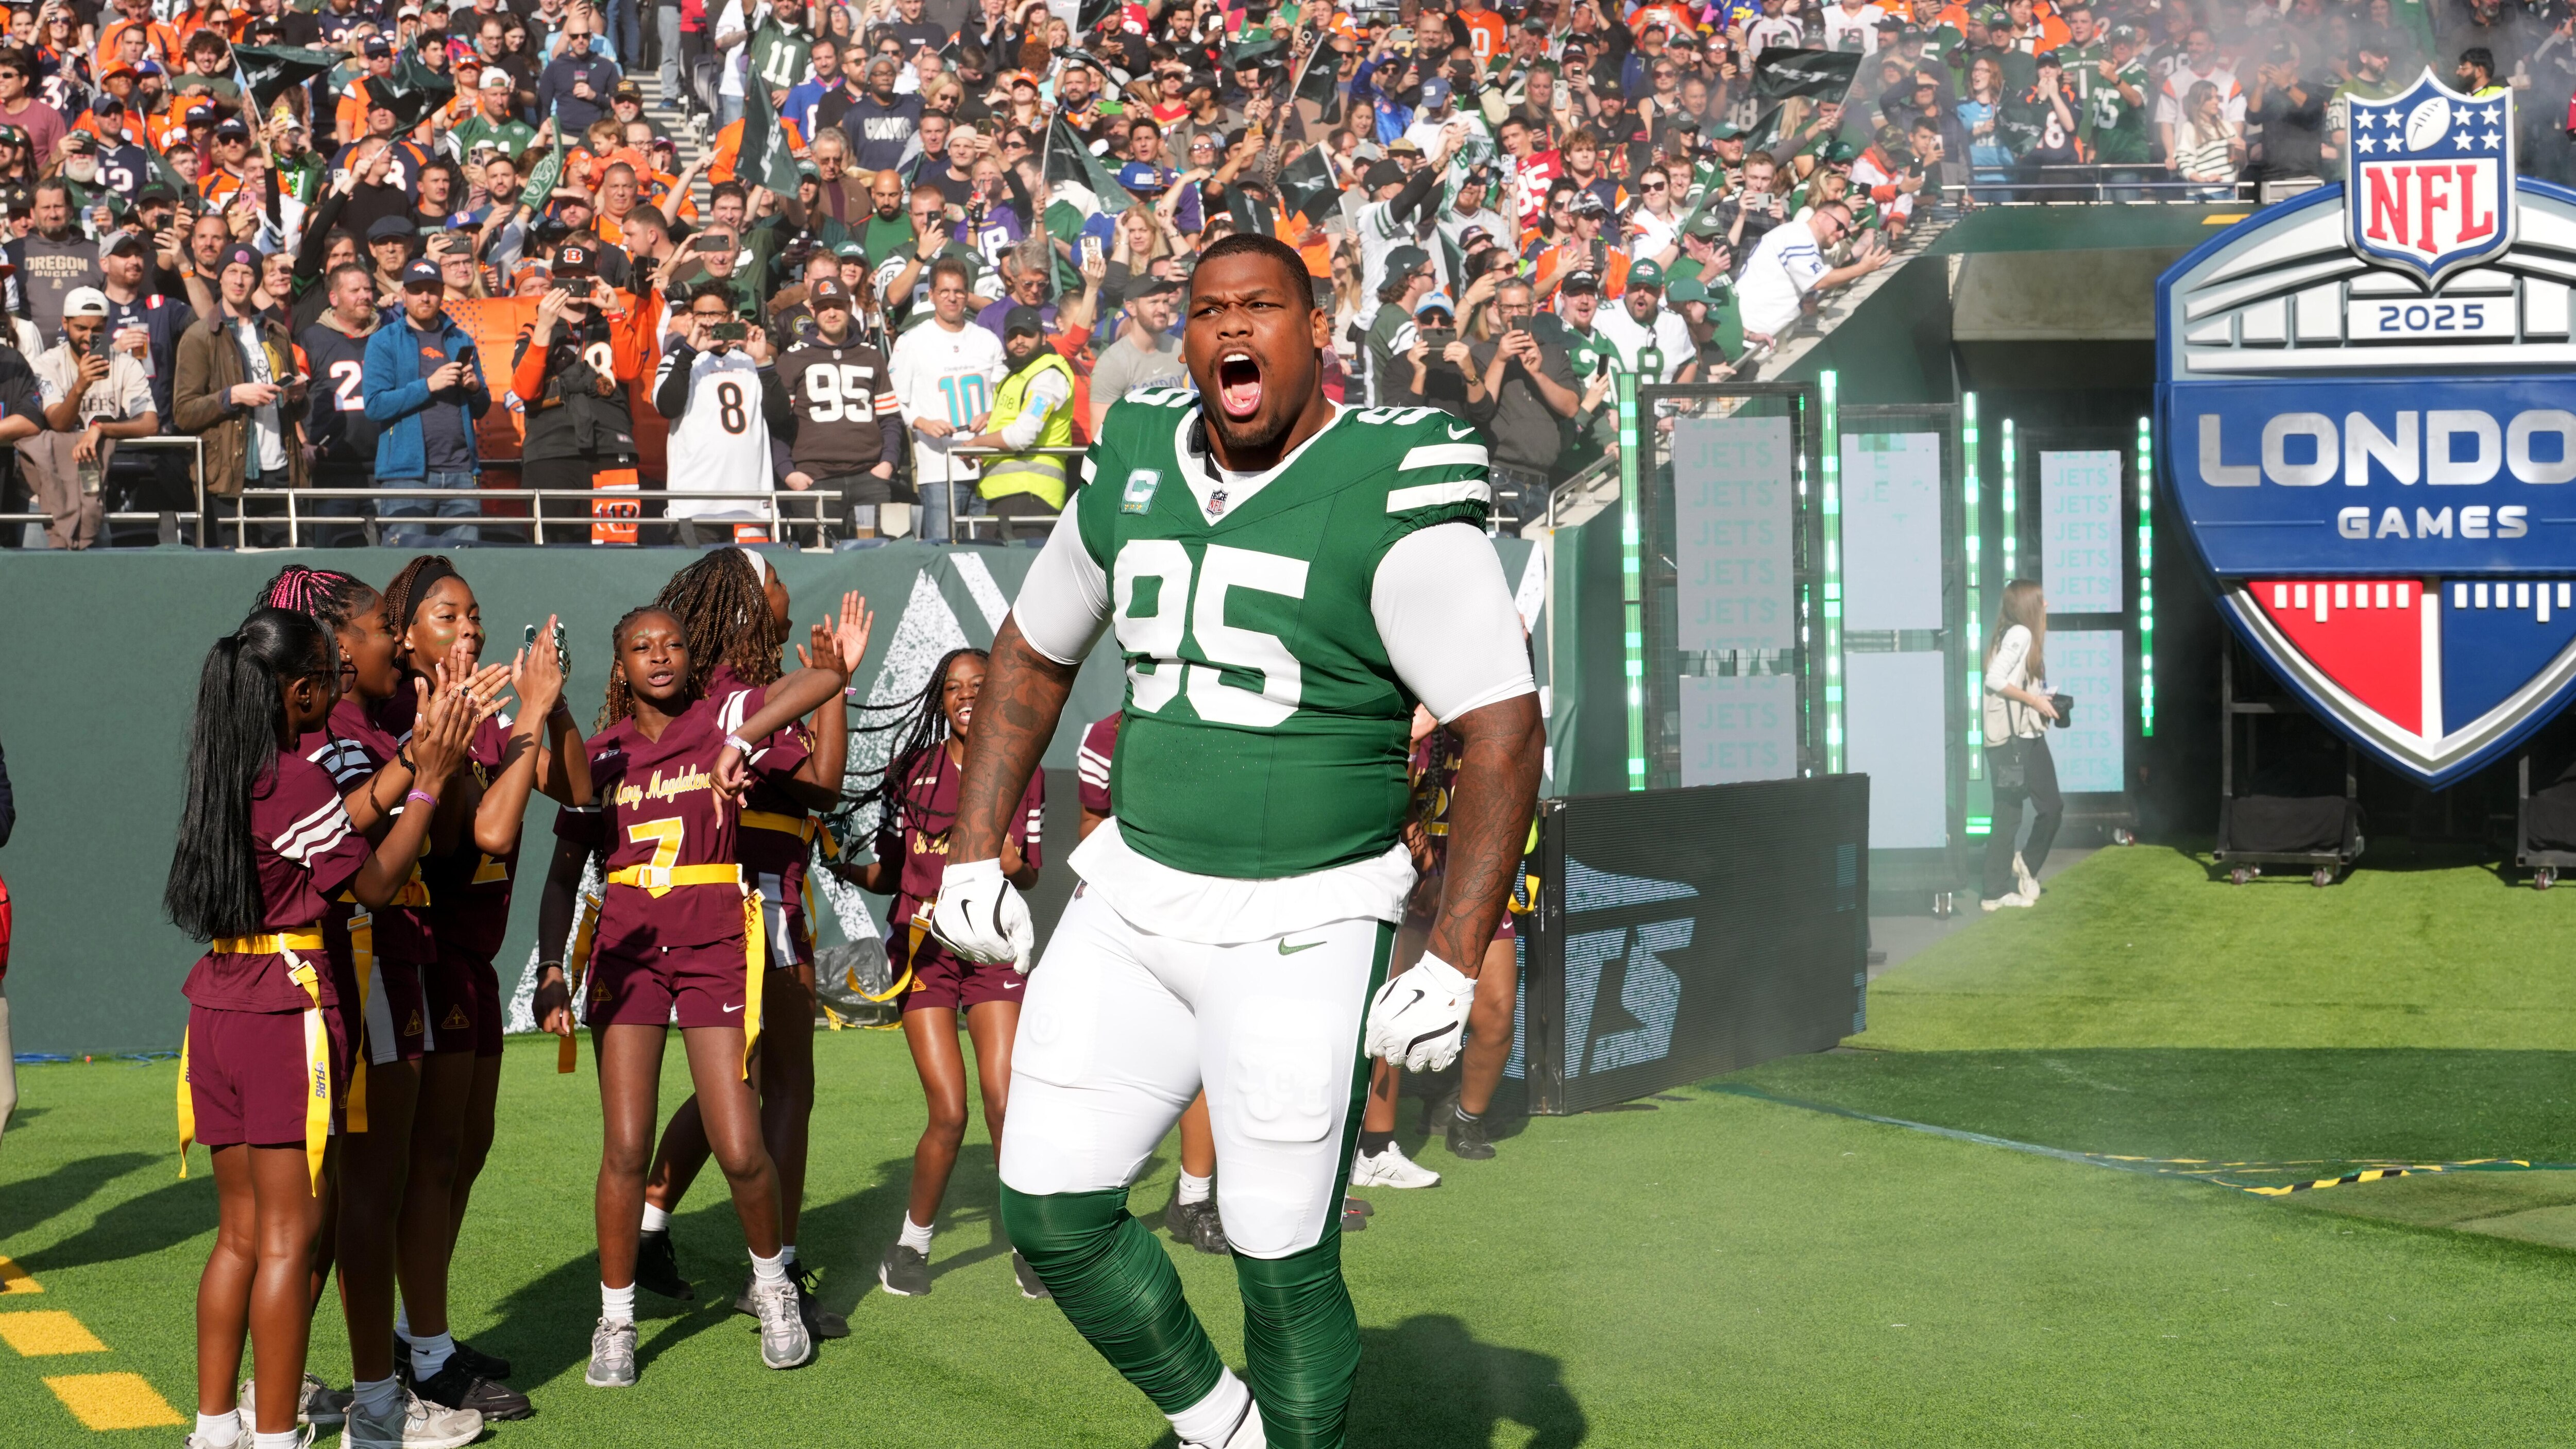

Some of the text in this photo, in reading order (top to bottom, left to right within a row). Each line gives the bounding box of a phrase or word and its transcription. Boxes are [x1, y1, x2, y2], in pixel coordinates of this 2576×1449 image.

[761, 41, 796, 87] 11
[2365, 165, 2493, 254] NFL
[25, 255, 88, 272] OREGON
[563, 248, 583, 264] B
[34, 269, 79, 278] DUCKS
[2379, 304, 2484, 332] 2025
[329, 361, 365, 412] 2
[805, 363, 873, 423] 95
[81, 395, 117, 412] IEFS
[717, 381, 747, 434] 8
[938, 373, 986, 428] 10
[1692, 442, 1774, 469] JETS
[2198, 409, 2576, 487] LONDO
[1124, 469, 1158, 503] C
[2053, 468, 2109, 486] JETS
[1208, 498, 1226, 513] NFL
[1693, 481, 1774, 508] JETS
[2053, 495, 2109, 514] JETS
[1693, 520, 1775, 547] JETS
[2054, 522, 2110, 541] JETS
[2337, 505, 2529, 540] GAMES
[2055, 550, 2110, 567] JETS
[1694, 559, 1775, 586] JETS
[2055, 577, 2111, 595] JETS
[1696, 598, 1776, 625] JETS
[1113, 539, 1310, 727] 95
[2055, 650, 2111, 668] JETS
[1698, 703, 1777, 730] JETS
[2072, 704, 2111, 722] ETS
[594, 749, 621, 762] JETS
[1699, 743, 1779, 769] JETS
[611, 778, 643, 811] Mary
[627, 816, 685, 871] 7
[315, 1070, 326, 1099] FLAG
